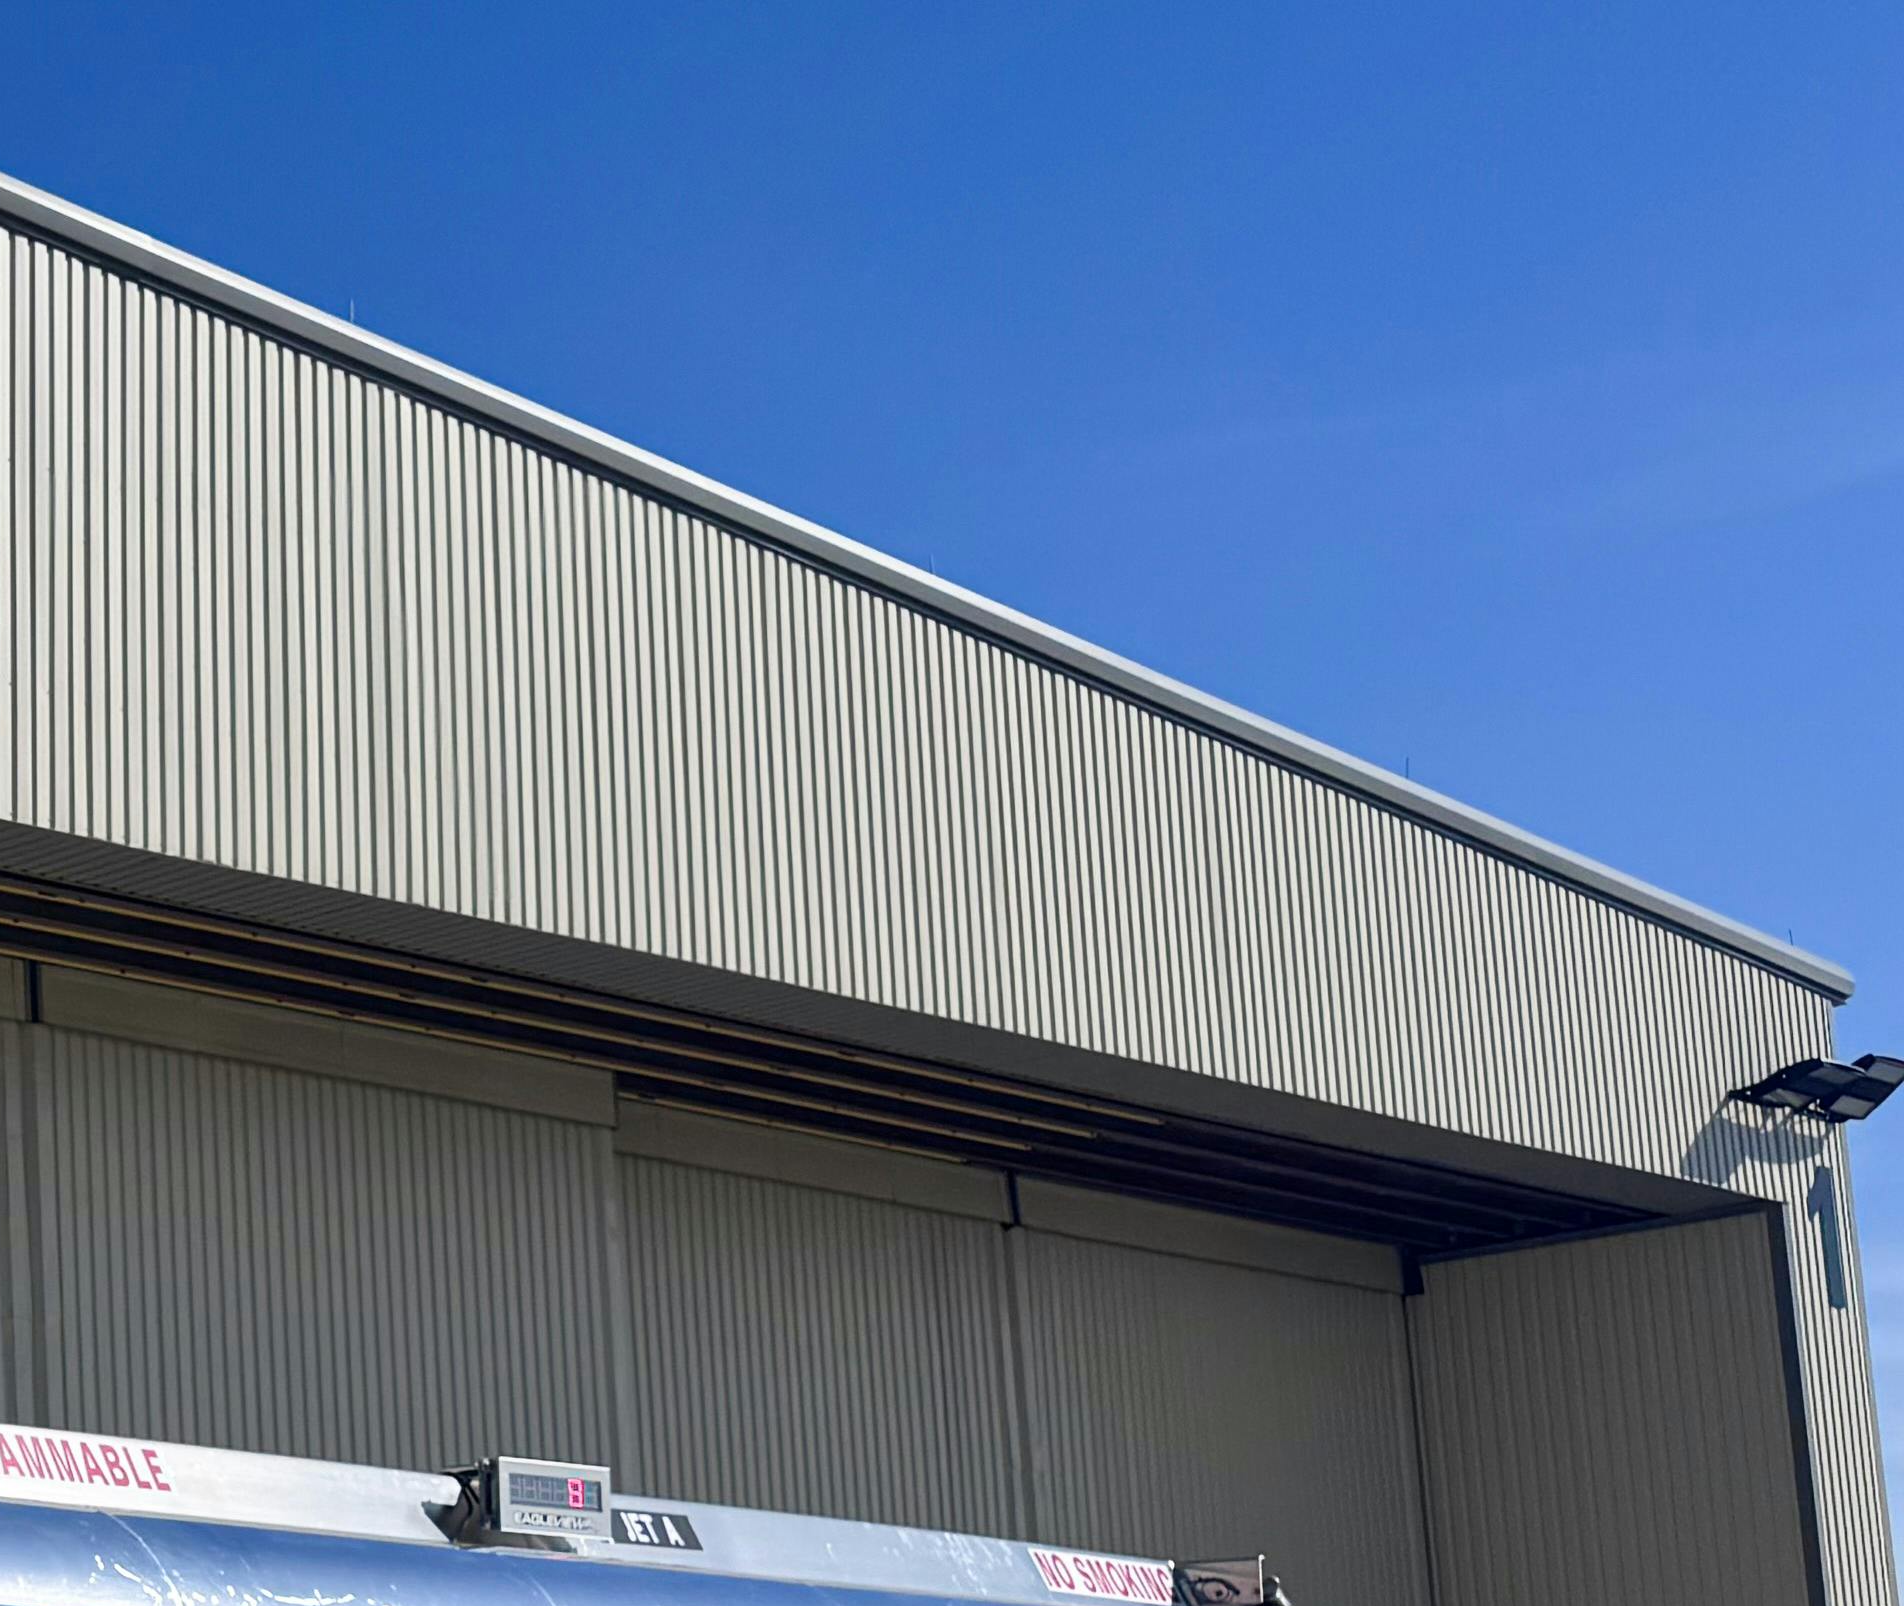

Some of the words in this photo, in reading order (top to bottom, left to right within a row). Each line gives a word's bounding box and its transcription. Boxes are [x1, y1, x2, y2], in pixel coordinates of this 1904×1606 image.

[1807, 1165, 1848, 1310] 1
[514, 1512, 583, 1530] EAGLEVIEW
[620, 1511, 659, 1544] JET
[662, 1516, 686, 1546] A
[1034, 1551, 1075, 1590] NO
